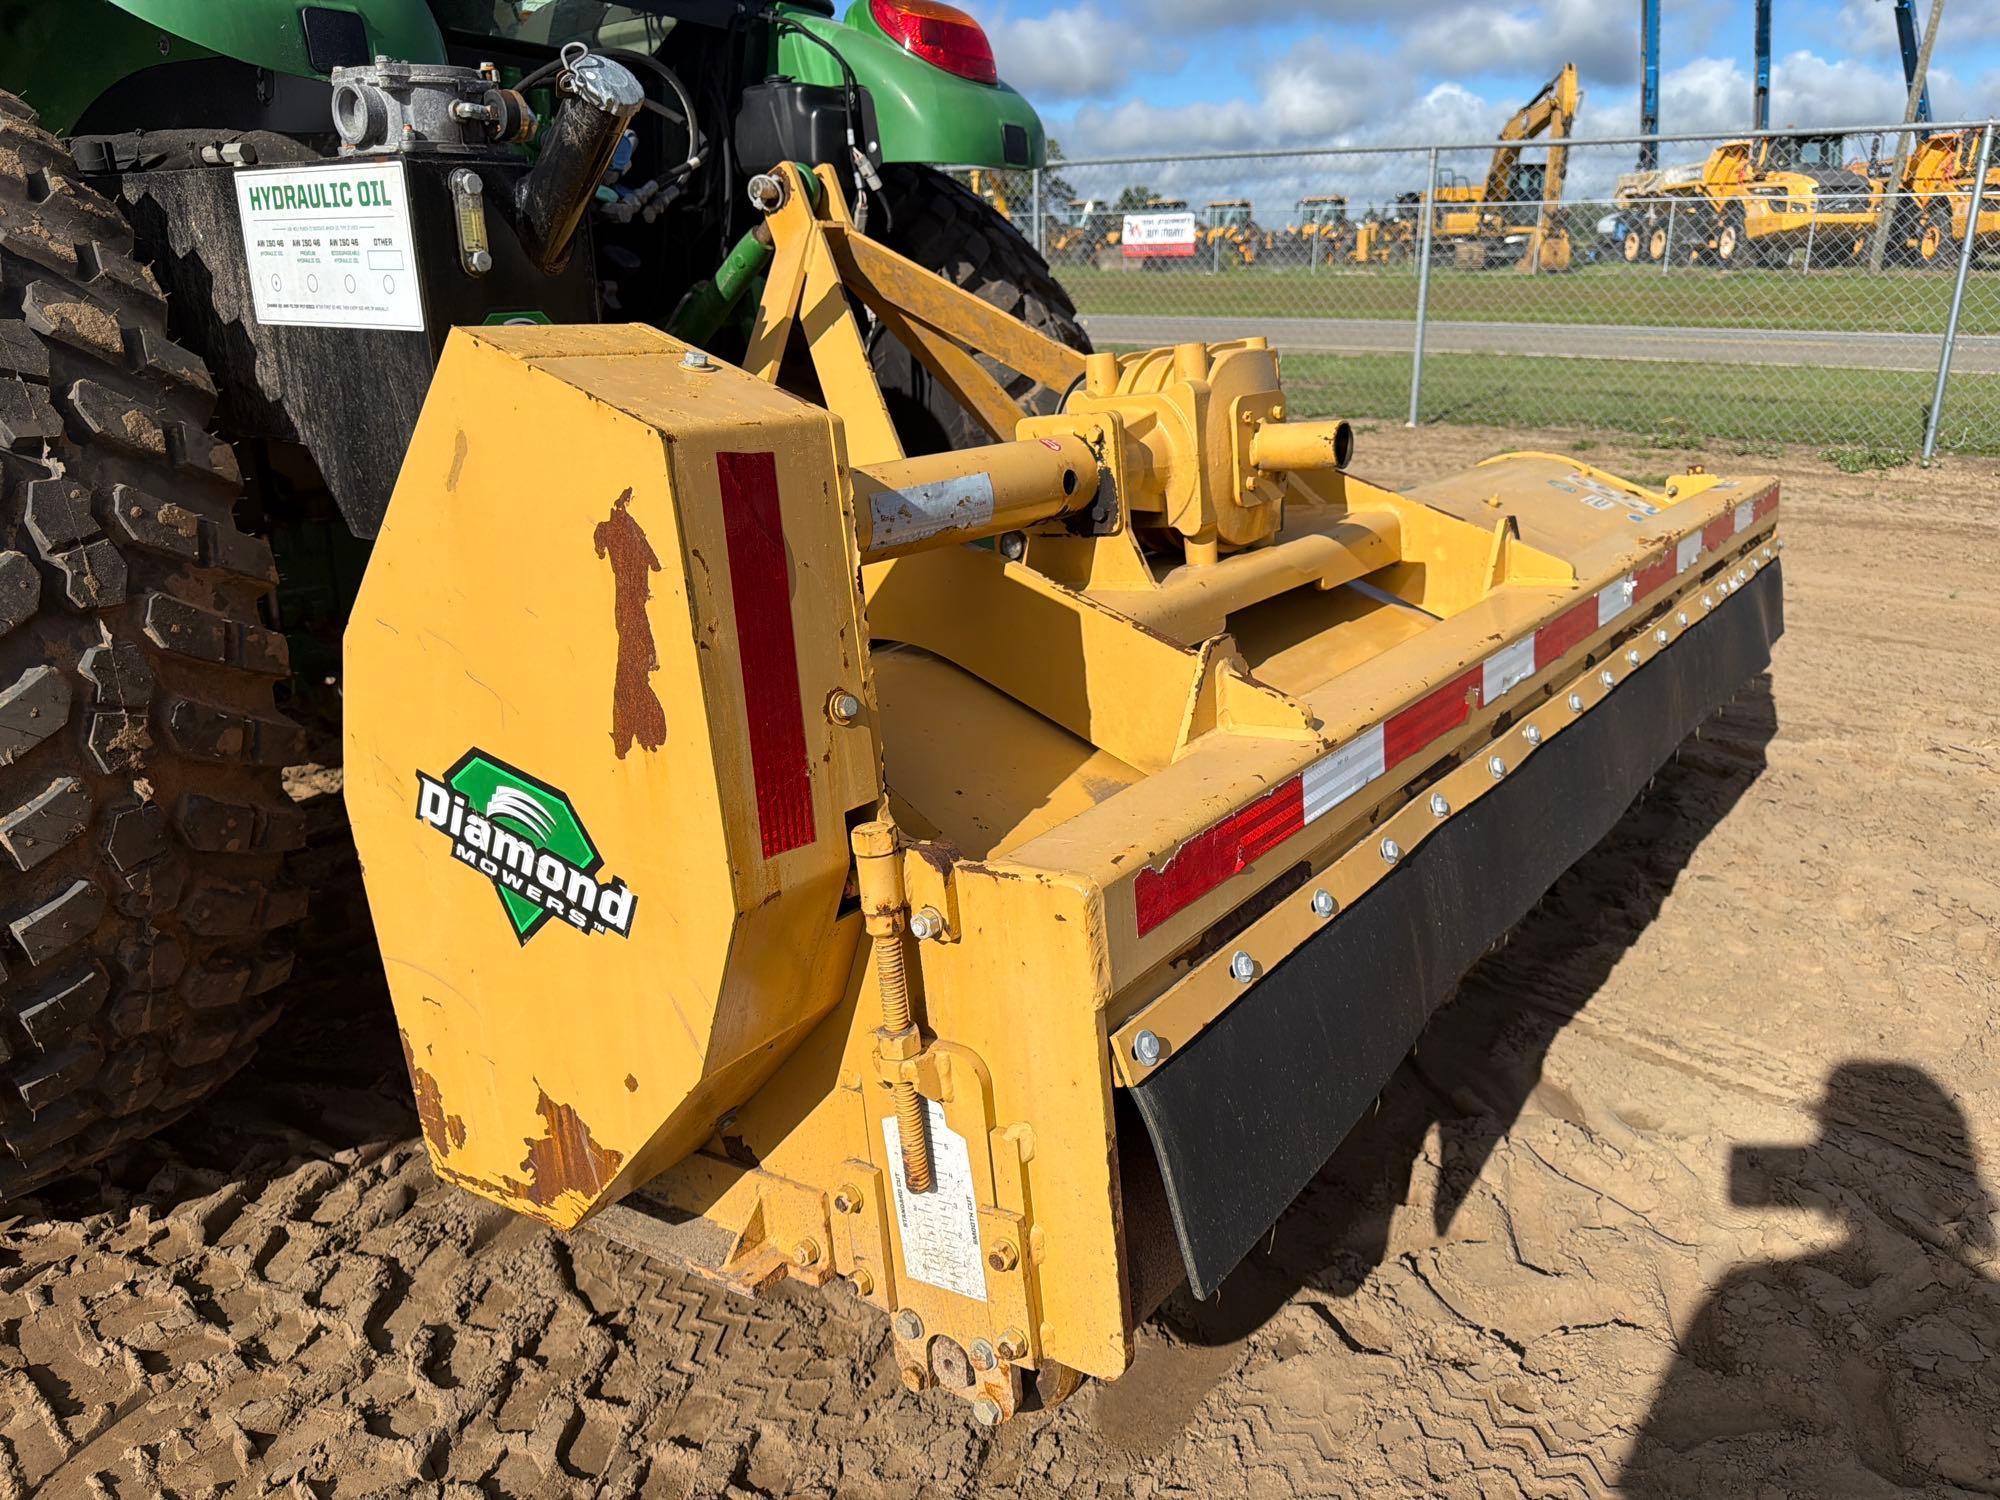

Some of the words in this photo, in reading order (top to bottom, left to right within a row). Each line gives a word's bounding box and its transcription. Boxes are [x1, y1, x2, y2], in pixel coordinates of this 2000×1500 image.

[249, 182, 353, 211] HYDRAULIC
[357, 180, 392, 207] OIL
[266, 239, 276, 247] ISO
[277, 239, 285, 247] 46
[302, 239, 312, 247] ISO
[313, 238, 321, 247] 46
[339, 238, 350, 246] ISO
[351, 238, 359, 246] 46
[373, 237, 393, 246] OTHER
[420, 777, 634, 931] Diamond
[455, 843, 588, 928] MOWERS
[894, 1172, 902, 1187] CUT
[897, 1188, 909, 1228] STANDARD
[965, 1195, 974, 1212] CUT
[969, 1213, 979, 1246] SMOOTH
